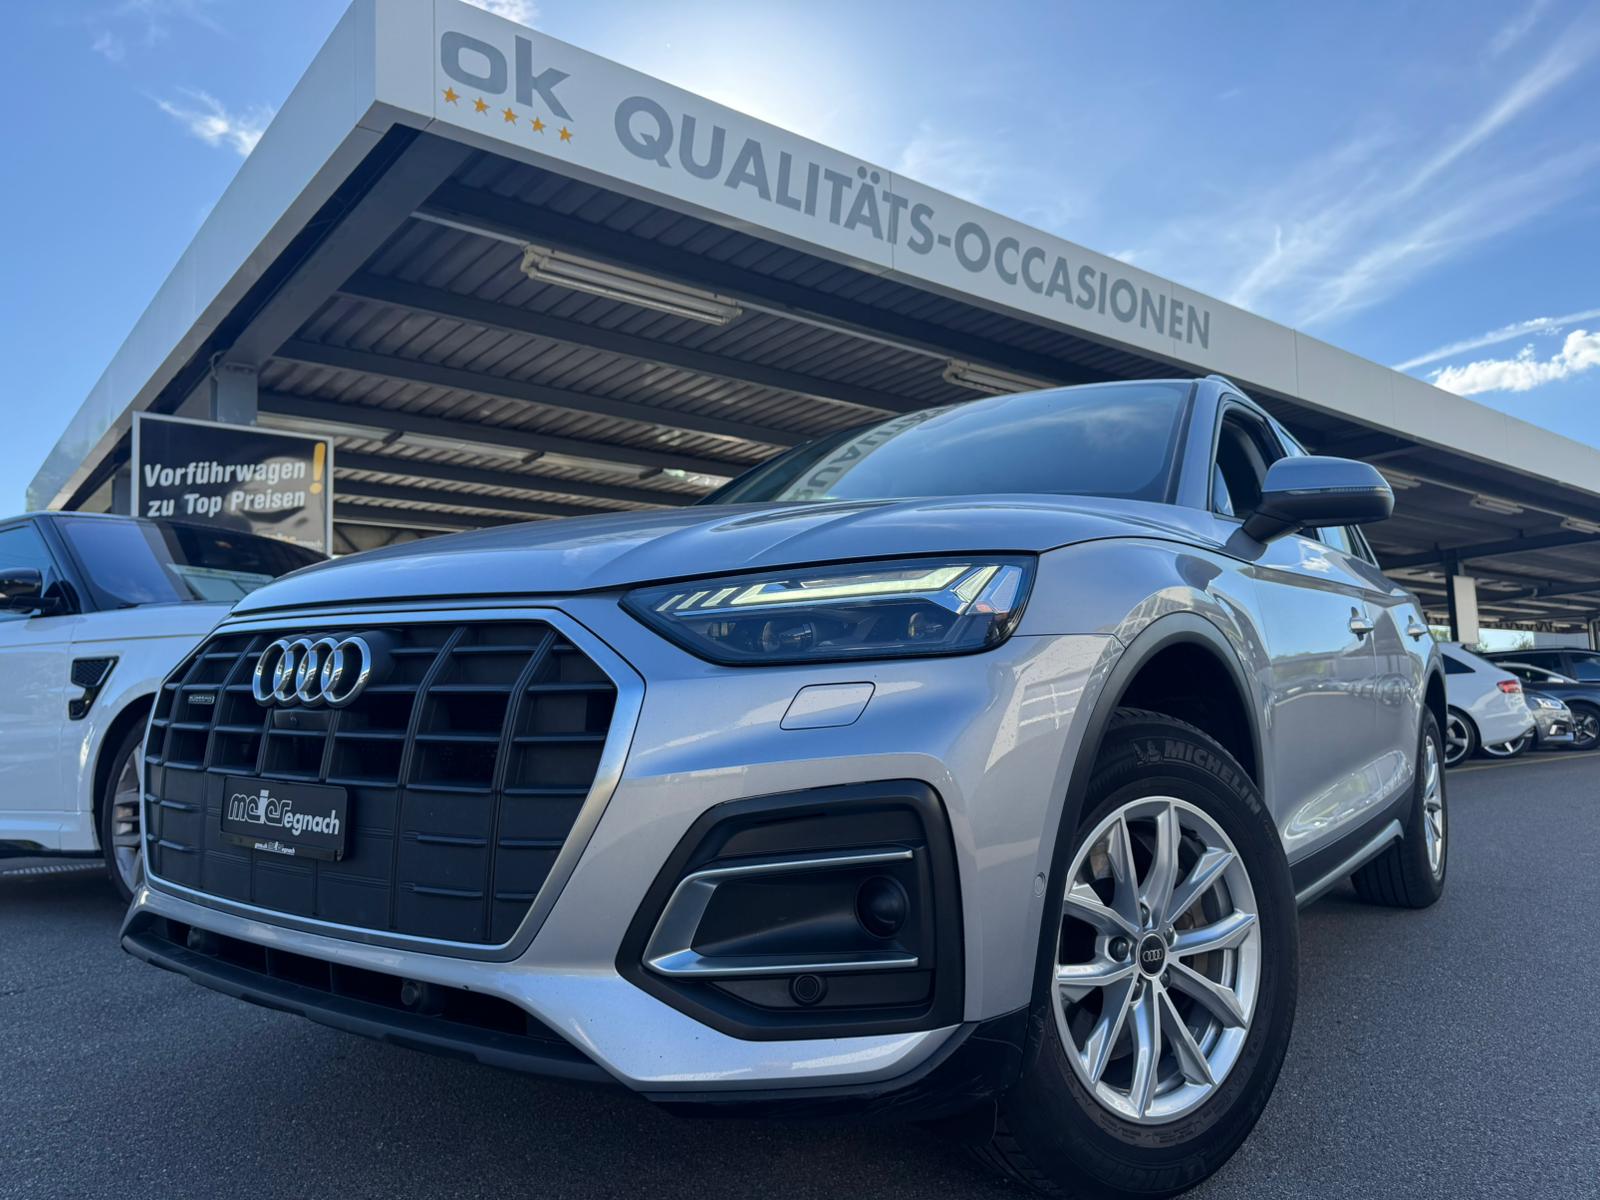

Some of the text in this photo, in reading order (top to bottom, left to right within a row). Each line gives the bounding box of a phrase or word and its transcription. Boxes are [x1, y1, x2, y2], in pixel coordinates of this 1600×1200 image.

[440, 31, 574, 122] ok
[614, 96, 1211, 349] QUALITÄTS-OCCASIONEN
[143, 461, 306, 487] Vorführwagen
[147, 490, 305, 517] zu Top Preisen
[1164, 739, 1262, 815] MICHELIN
